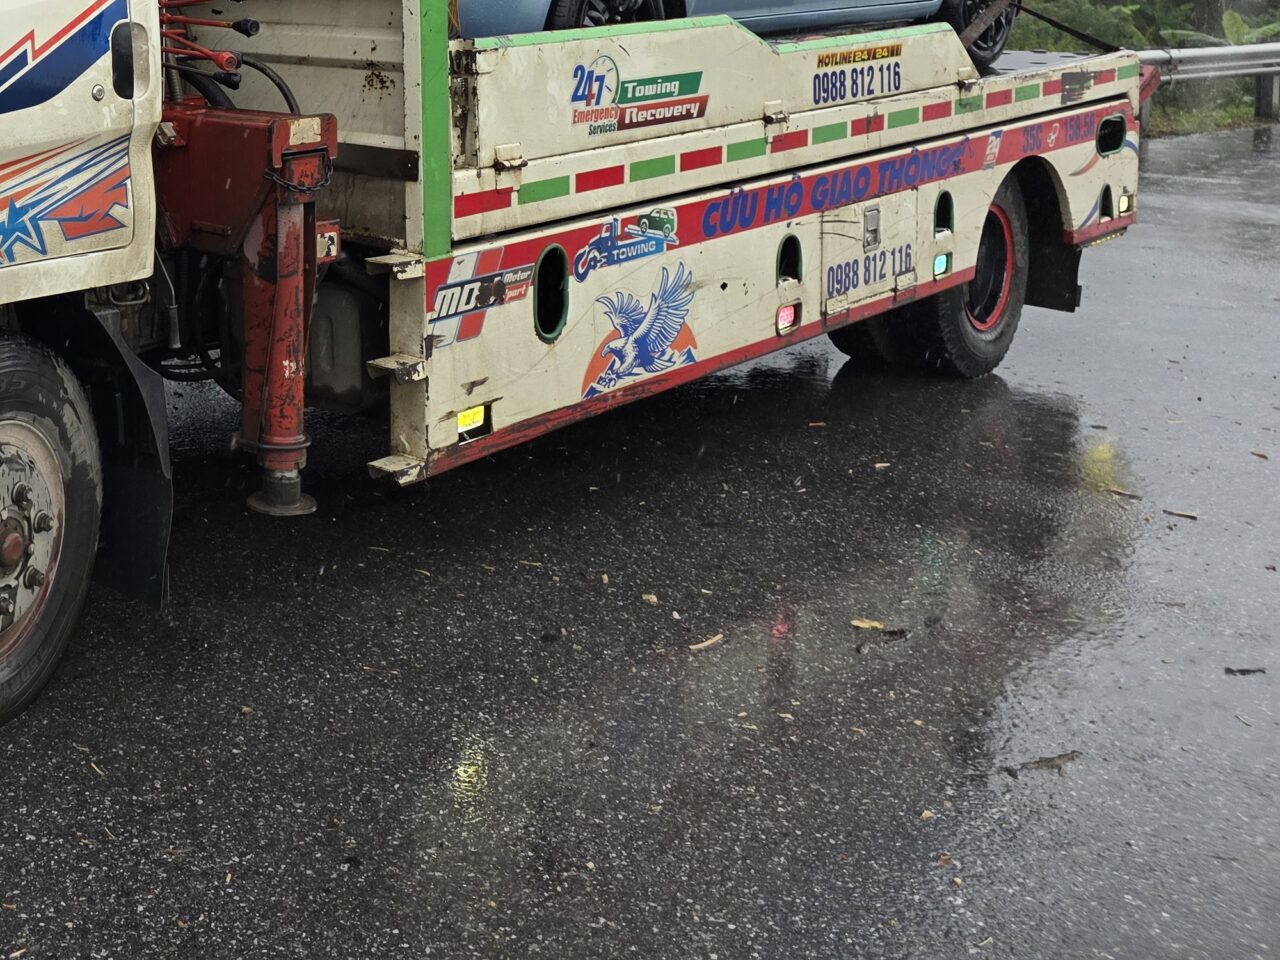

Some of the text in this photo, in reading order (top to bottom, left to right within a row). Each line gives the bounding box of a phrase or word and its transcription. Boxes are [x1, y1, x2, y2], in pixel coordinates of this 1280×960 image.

[817, 52, 852, 68] HOTLINE
[624, 79, 680, 98] Towing
[813, 61, 901, 105] 0988 812 116
[572, 106, 620, 125] Emergency
[624, 102, 700, 124] Recovery
[588, 122, 616, 135] Services
[702, 145, 960, 238] CỨU HỘ GIAO THÔNG
[612, 240, 656, 261] TOWING
[504, 270, 531, 283] Motor
[827, 243, 912, 298] 0988 812 116
[504, 285, 527, 301] port
